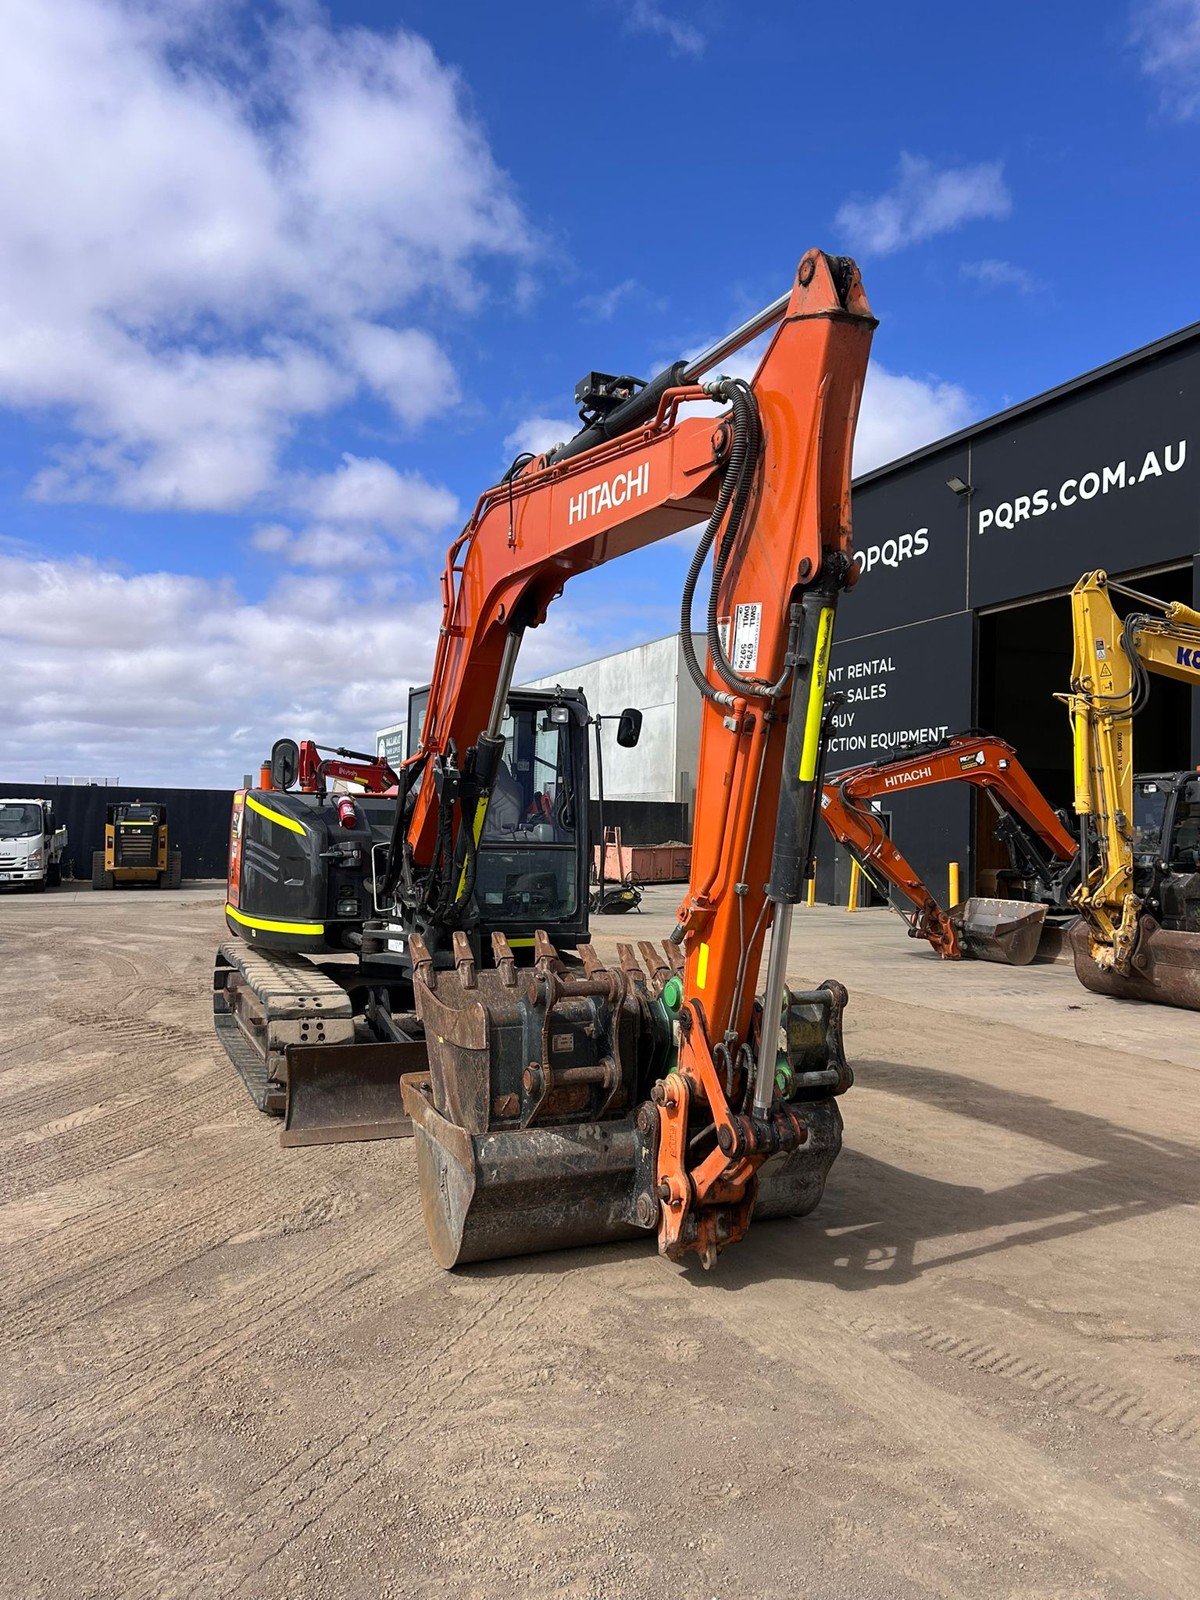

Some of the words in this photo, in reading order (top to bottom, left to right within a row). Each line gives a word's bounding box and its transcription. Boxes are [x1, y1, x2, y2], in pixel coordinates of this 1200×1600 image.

[568, 461, 650, 526] HITACHI
[978, 439, 1186, 535] PQRS.COM.AU
[828, 667, 844, 683] NT
[847, 657, 896, 680] RENTAL
[847, 683, 887, 703] SALES
[831, 712, 855, 728] BUY
[870, 726, 949, 749] EQUIPMENT
[884, 766, 932, 787] HITACHI
